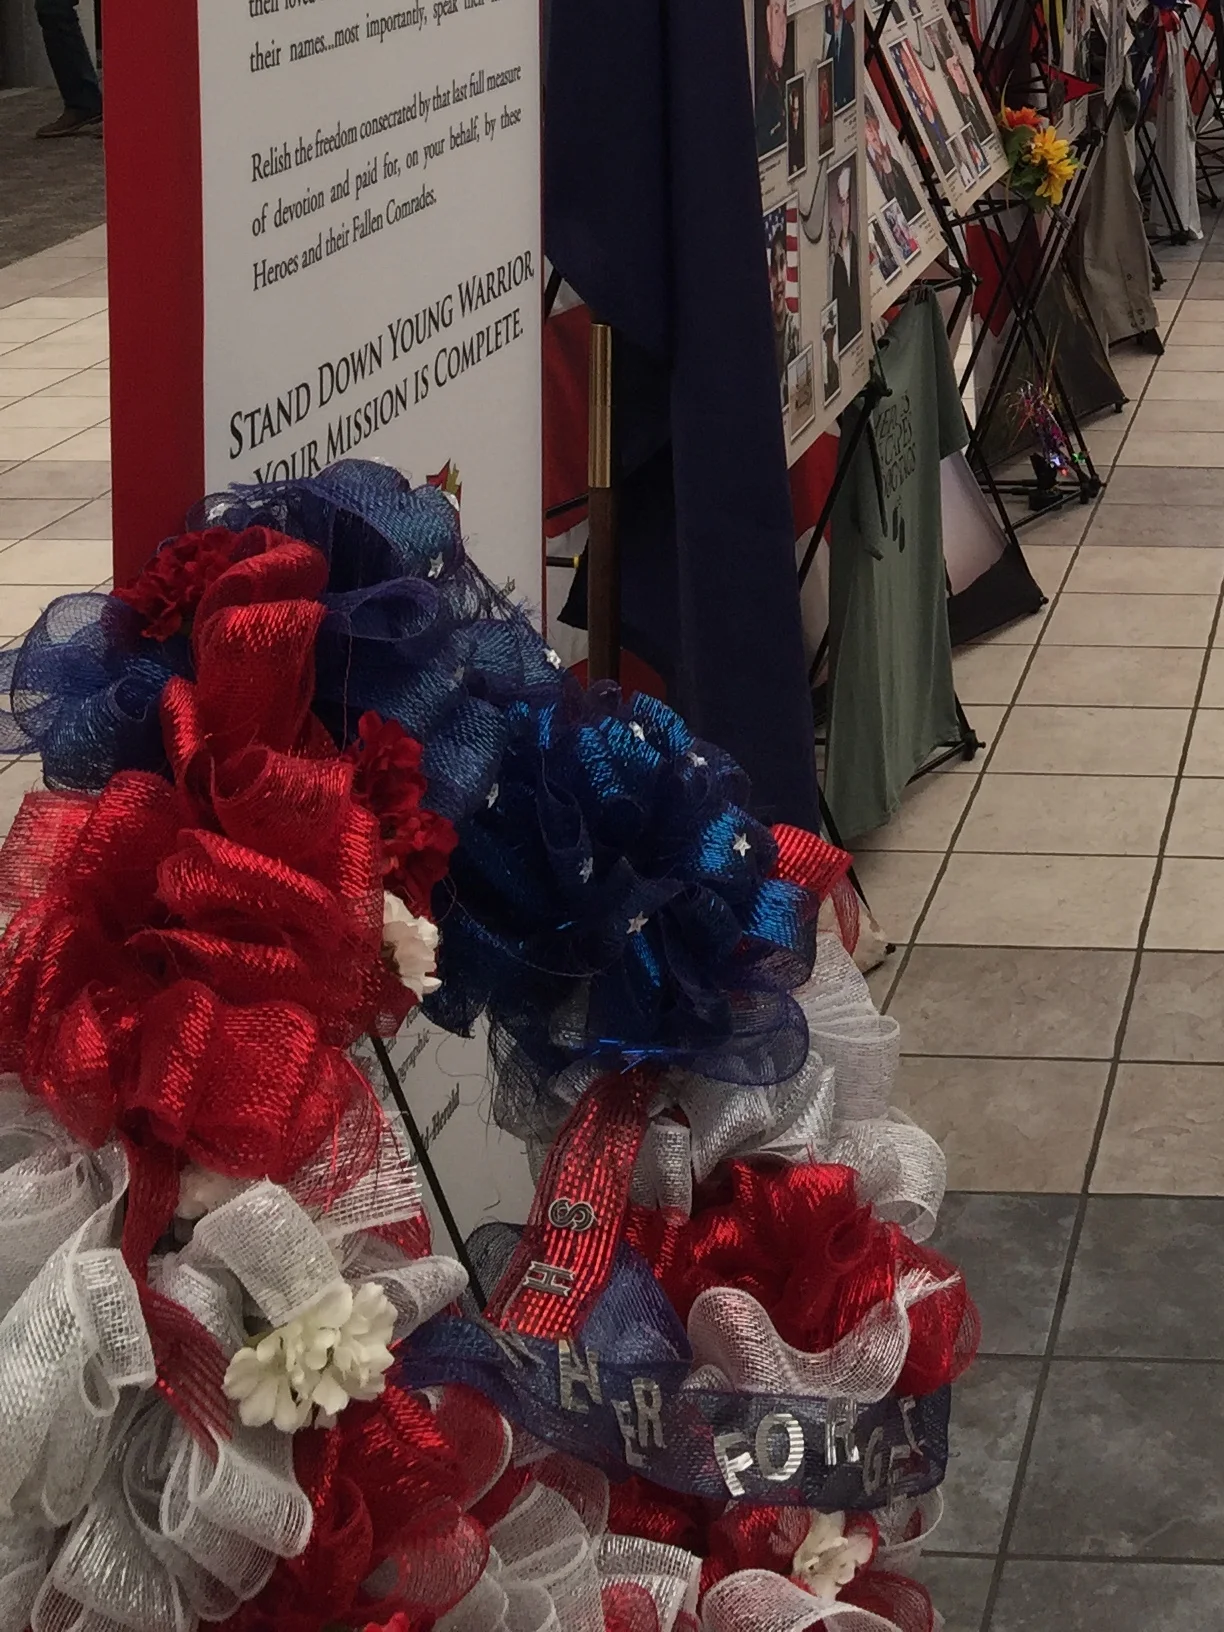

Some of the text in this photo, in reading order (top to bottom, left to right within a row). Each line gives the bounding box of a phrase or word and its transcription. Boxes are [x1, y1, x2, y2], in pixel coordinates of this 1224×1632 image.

[249, 39, 281, 73] their
[251, 66, 521, 182] Relish the freedom consecrated by that last full measure
[252, 105, 521, 237] of devotion and paid for, on your behalf, by these
[253, 183, 437, 291] Heroes and their Fallen Comrades.
[229, 382, 311, 459] STAND
[317, 335, 383, 408] DOWN
[388, 294, 454, 361] YOUNG
[326, 379, 407, 464] MISSION
[414, 364, 429, 404] IS
[434, 307, 523, 387] COMPLETE.
